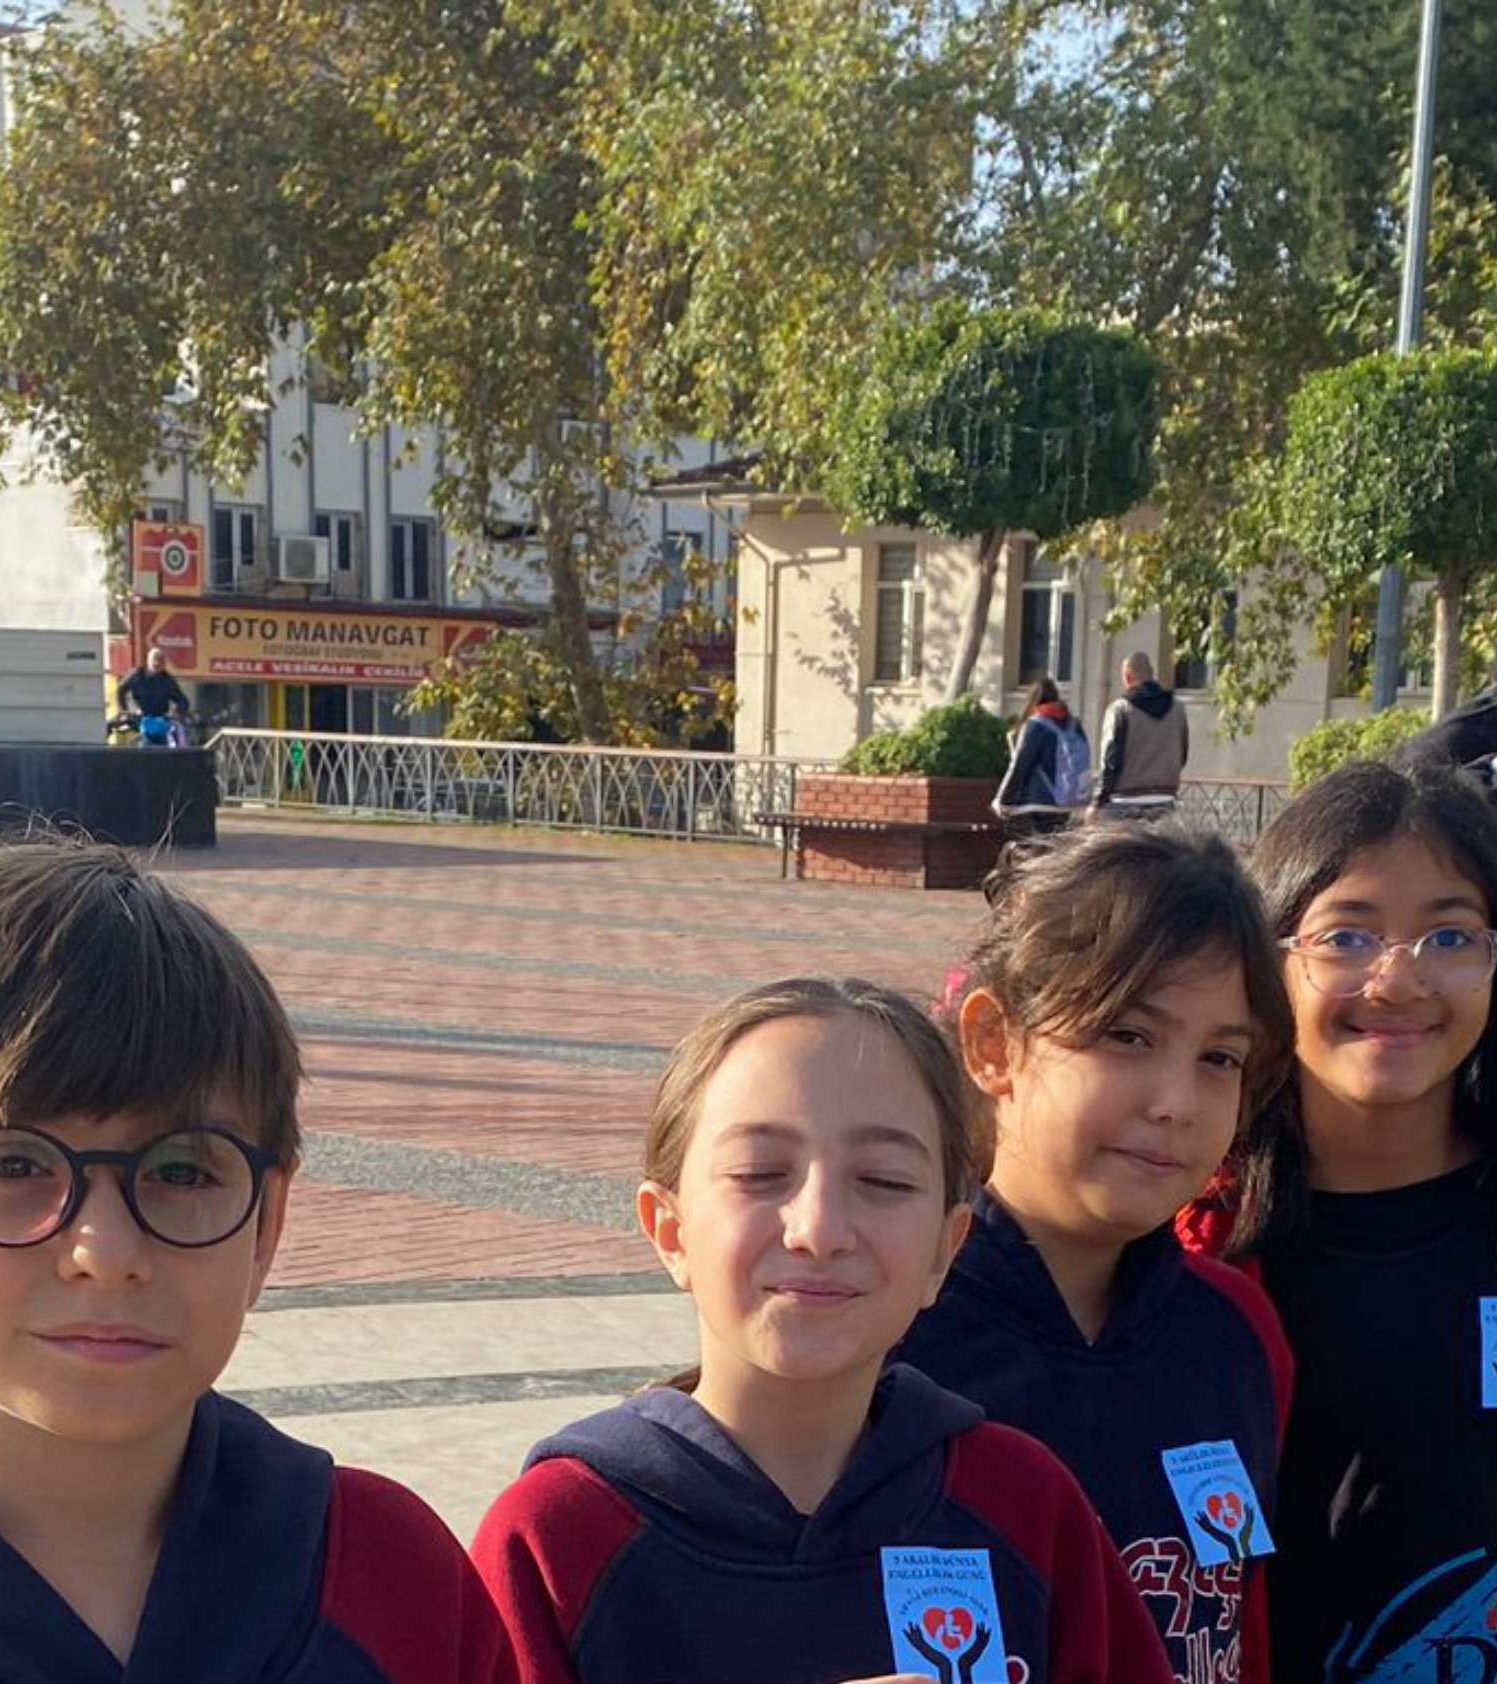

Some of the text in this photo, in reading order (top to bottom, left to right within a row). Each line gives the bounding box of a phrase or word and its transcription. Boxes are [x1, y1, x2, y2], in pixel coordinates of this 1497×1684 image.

[210, 615, 430, 646] FOTO MANAVGAT
[213, 661, 263, 674] ACELE
